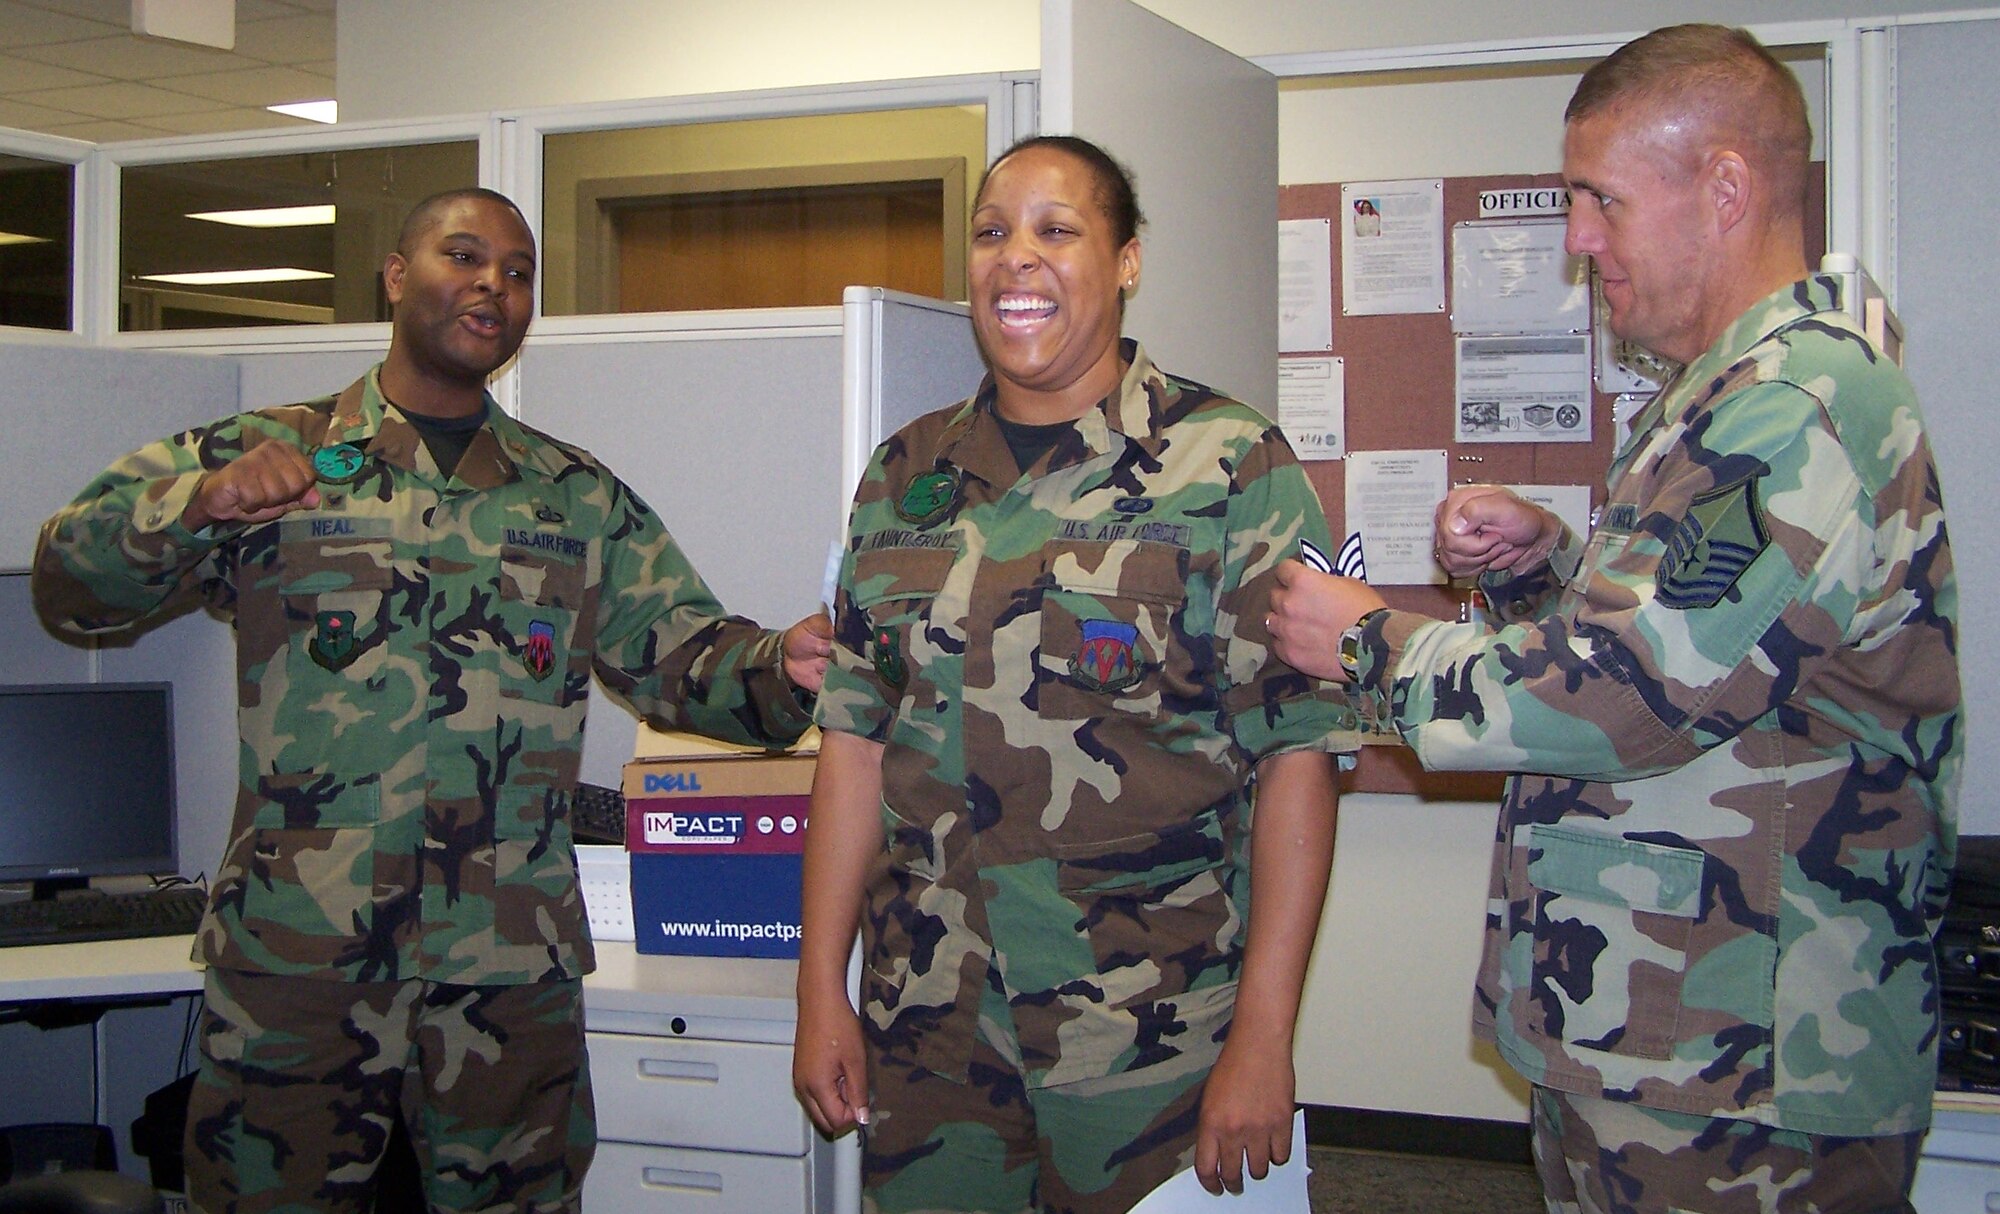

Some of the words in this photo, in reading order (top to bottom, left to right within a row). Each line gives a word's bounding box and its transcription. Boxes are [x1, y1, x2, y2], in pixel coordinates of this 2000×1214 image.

[312, 518, 356, 537] NEAL
[1064, 521, 1089, 540] U.S.
[1096, 524, 1127, 541] AIR
[1132, 521, 1185, 545] FORCE
[506, 528, 534, 546] U.S.
[532, 532, 555, 551] AIR
[555, 536, 588, 558] FORCE
[644, 772, 702, 792] DELL
[647, 816, 743, 833] IMPACT
